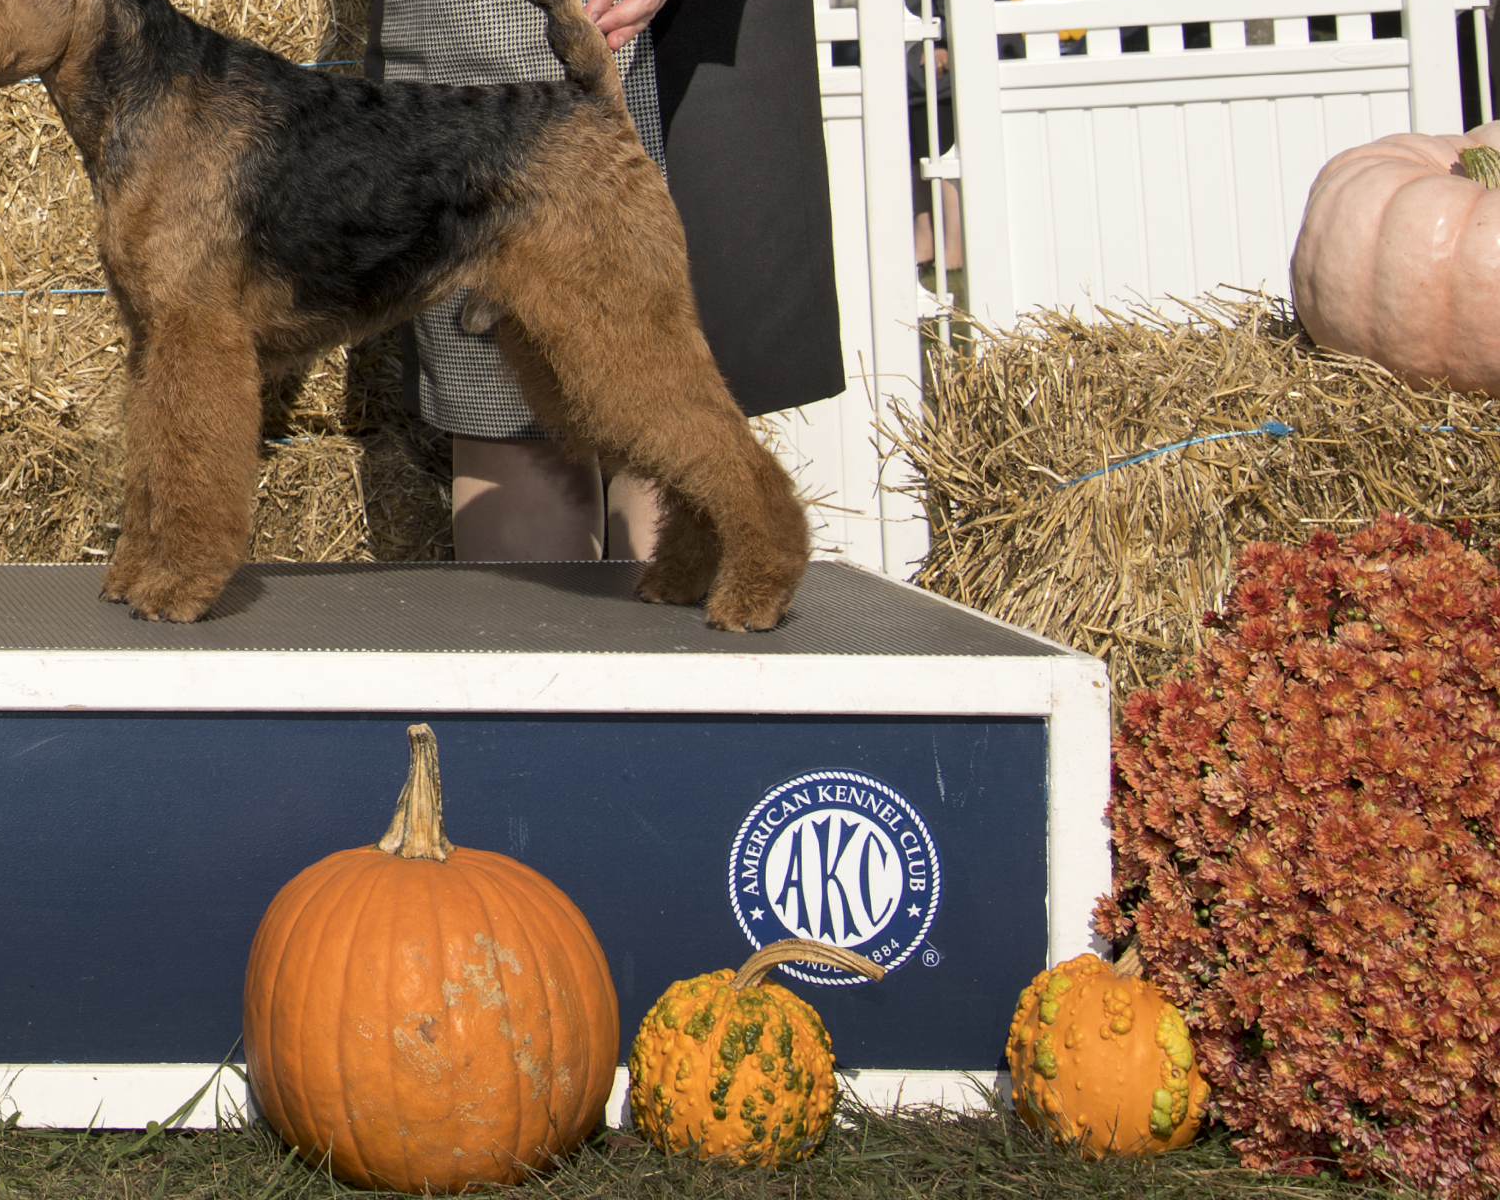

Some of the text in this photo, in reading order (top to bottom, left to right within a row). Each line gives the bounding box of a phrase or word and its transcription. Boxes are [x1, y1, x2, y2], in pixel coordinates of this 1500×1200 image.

[741, 785, 926, 896] AMERICAN KENNEL CLUB
[775, 814, 894, 945] AKC
